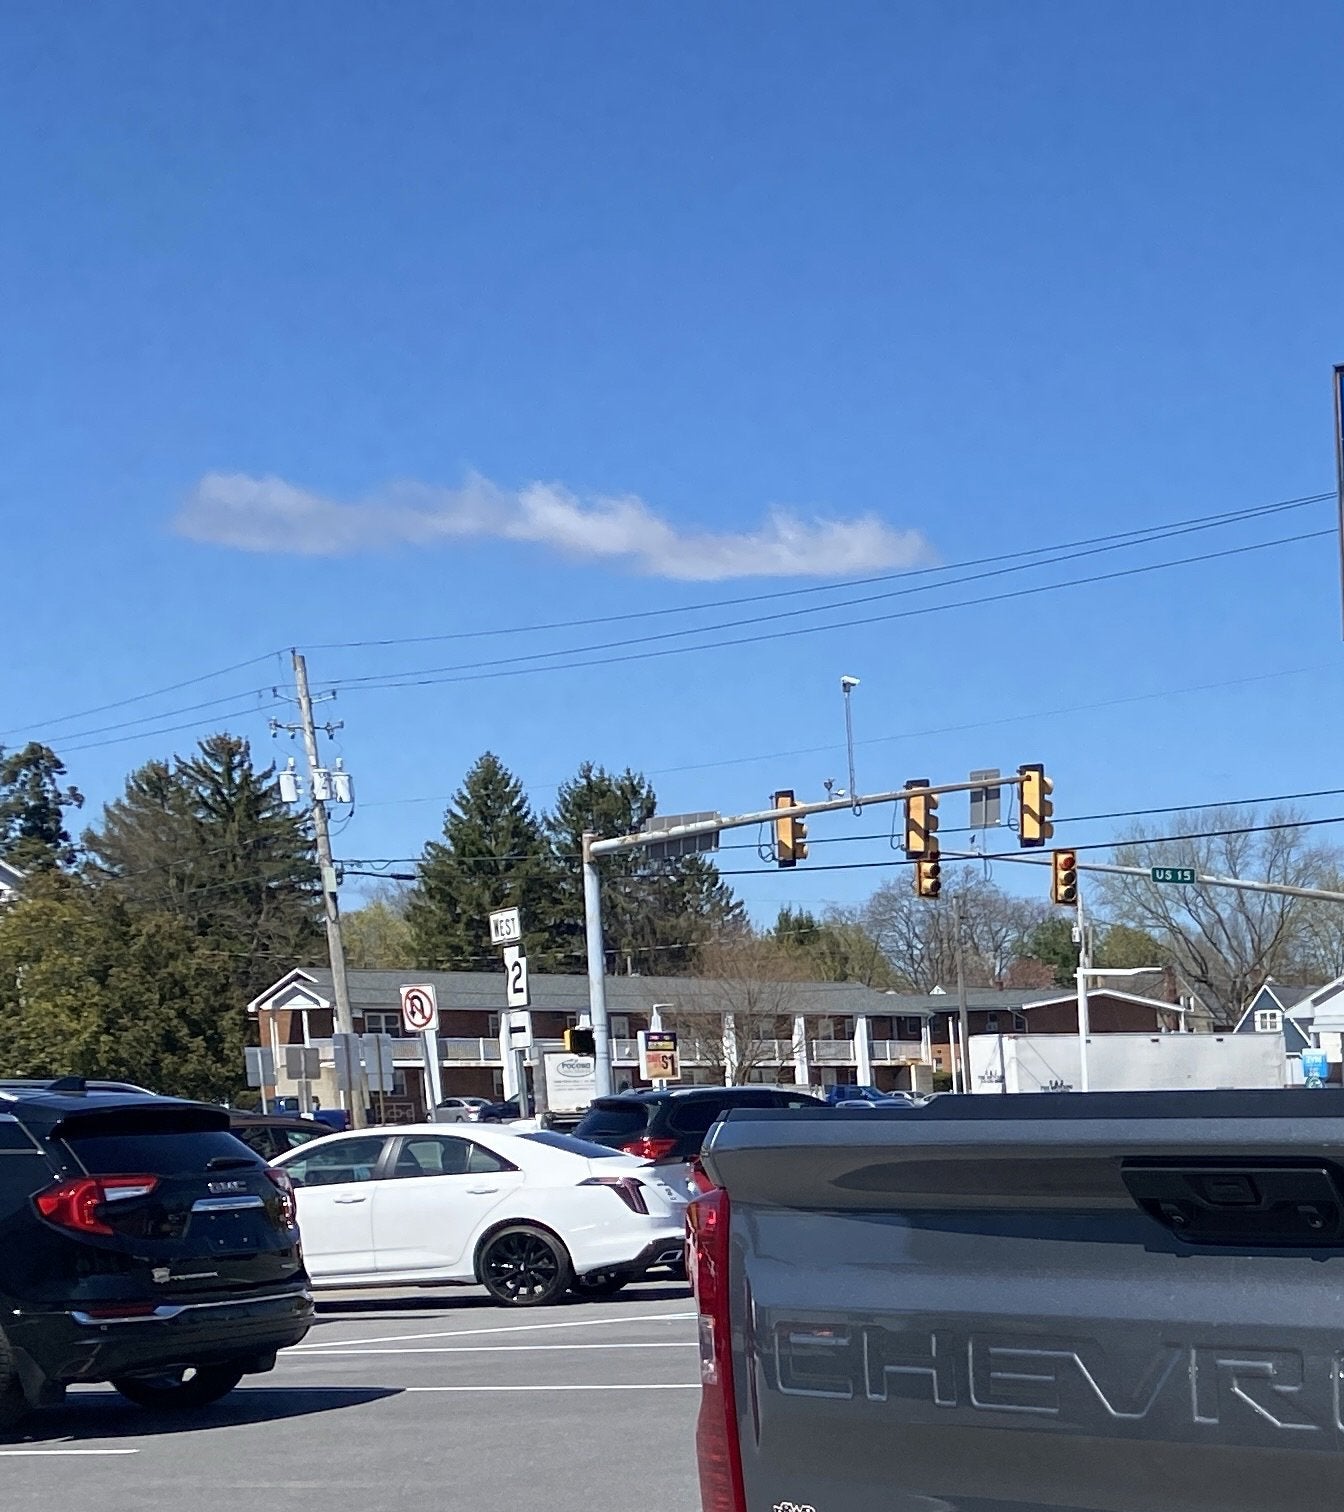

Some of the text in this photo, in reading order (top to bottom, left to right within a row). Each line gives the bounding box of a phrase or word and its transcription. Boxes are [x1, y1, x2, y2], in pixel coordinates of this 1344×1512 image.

[1155, 869, 1191, 881] US 15
[493, 917, 516, 937] WEST
